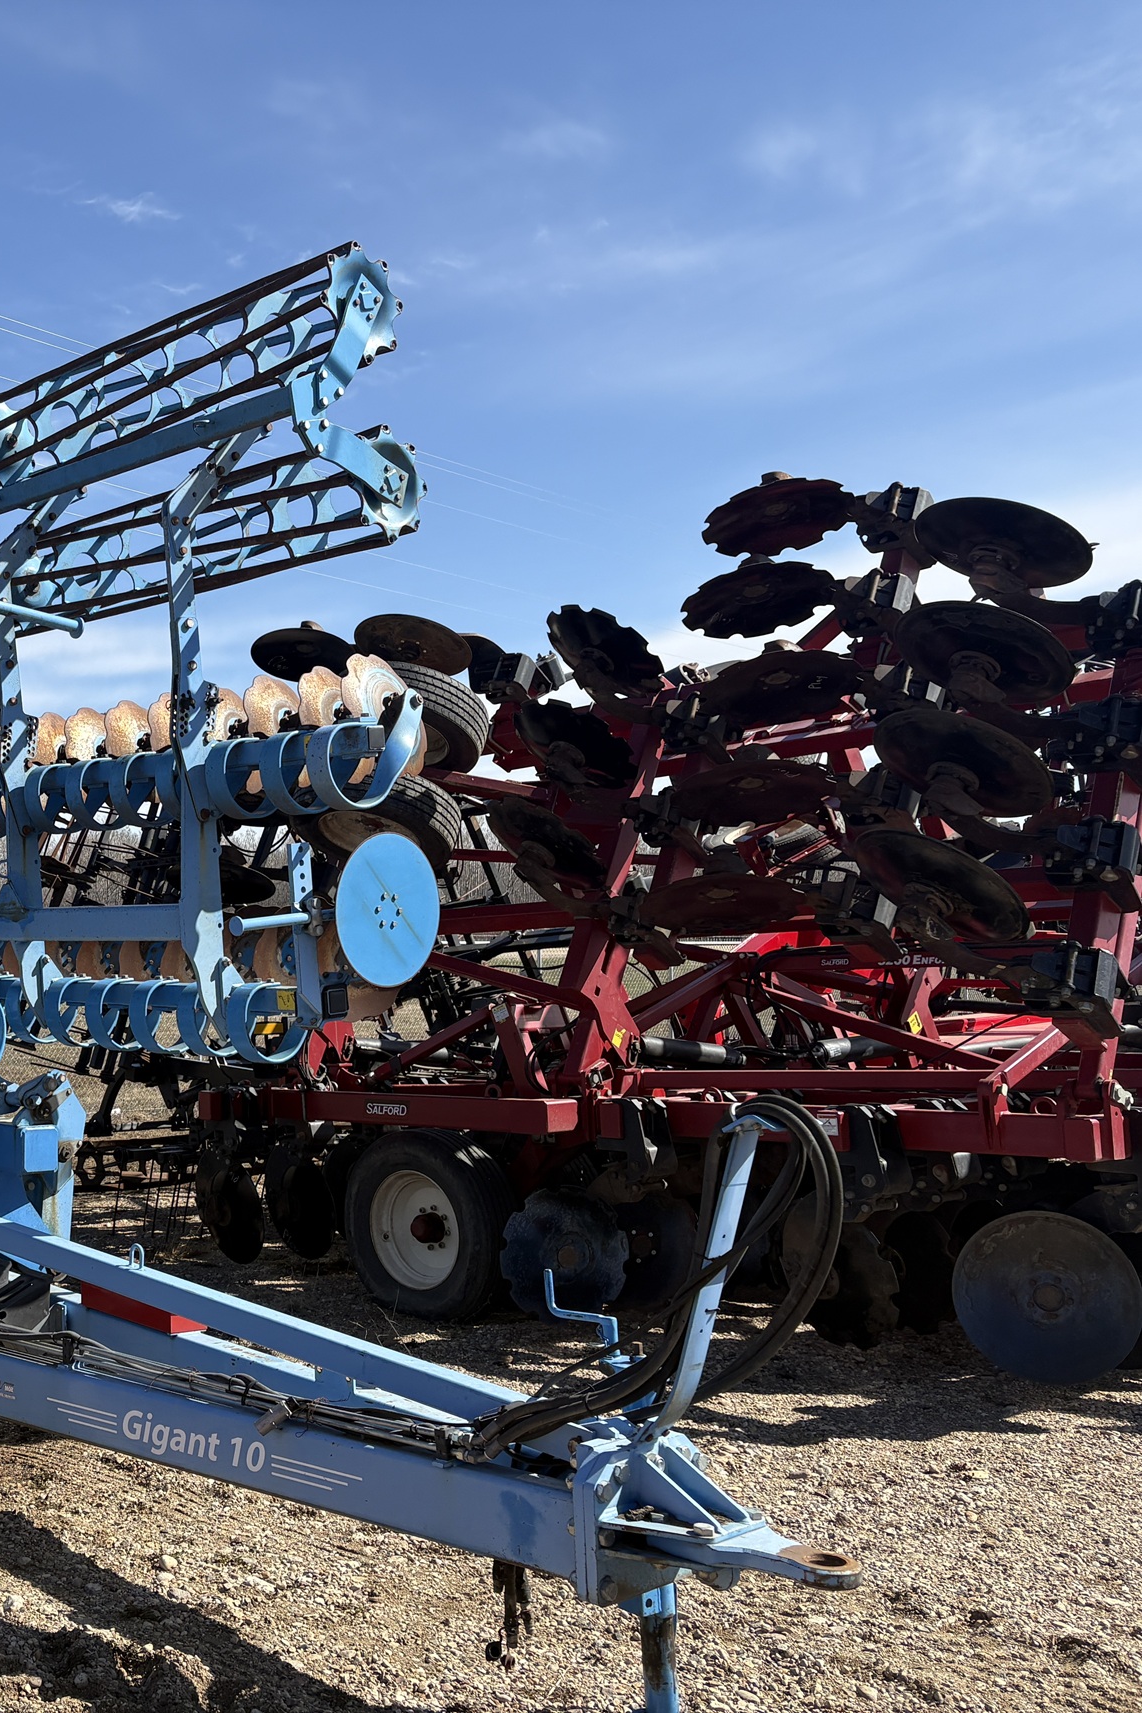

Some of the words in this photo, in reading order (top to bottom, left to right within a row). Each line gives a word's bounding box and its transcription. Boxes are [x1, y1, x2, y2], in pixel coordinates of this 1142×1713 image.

[366, 1102, 407, 1116] SALFORD
[122, 1410, 221, 1462] Gigant
[231, 1437, 266, 1473] 10
